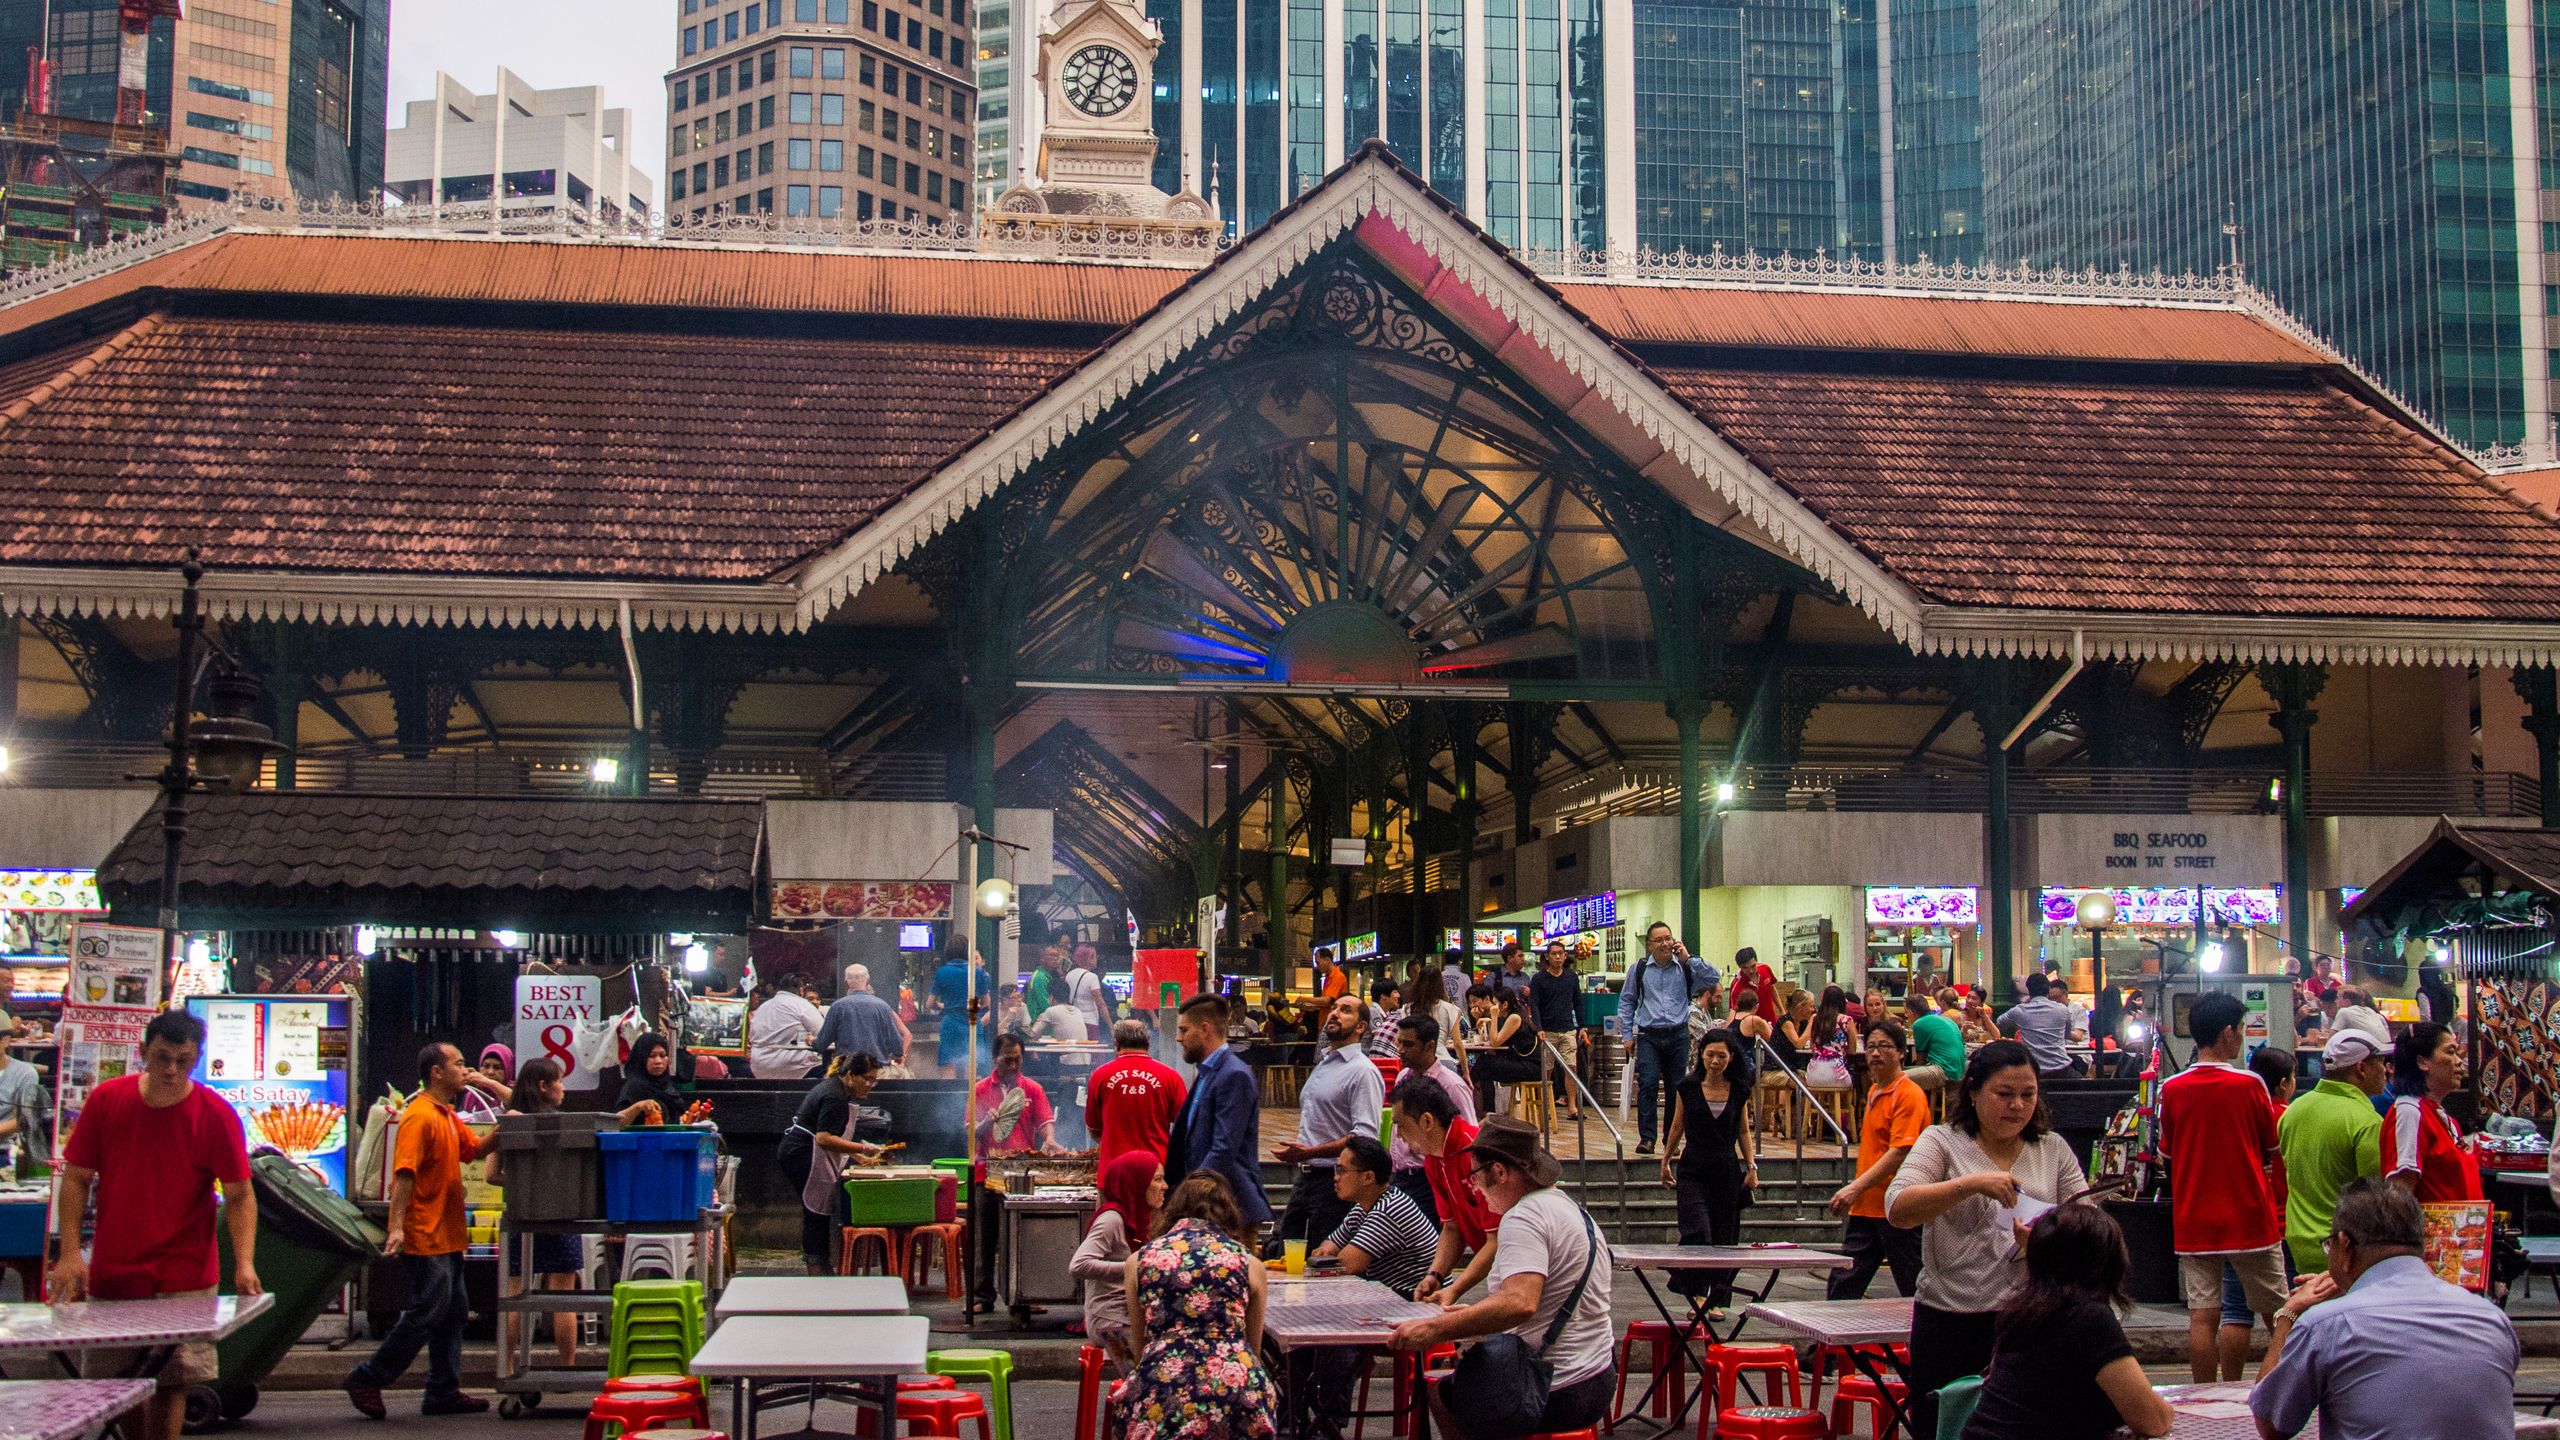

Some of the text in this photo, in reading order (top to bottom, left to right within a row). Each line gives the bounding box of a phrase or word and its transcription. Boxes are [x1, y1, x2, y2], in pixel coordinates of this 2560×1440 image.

[2114, 833, 2207, 849] BBQ SEAFOOD
[2105, 856, 2216, 868] BOON TAT STREET
[530, 985, 586, 1001] BEST
[521, 1004, 594, 1020] SATAY
[540, 1024, 576, 1079] 8
[1106, 1069, 1162, 1090] BEST SATAY
[252, 1086, 309, 1105] Satay
[1121, 1084, 1146, 1095] 7&8
